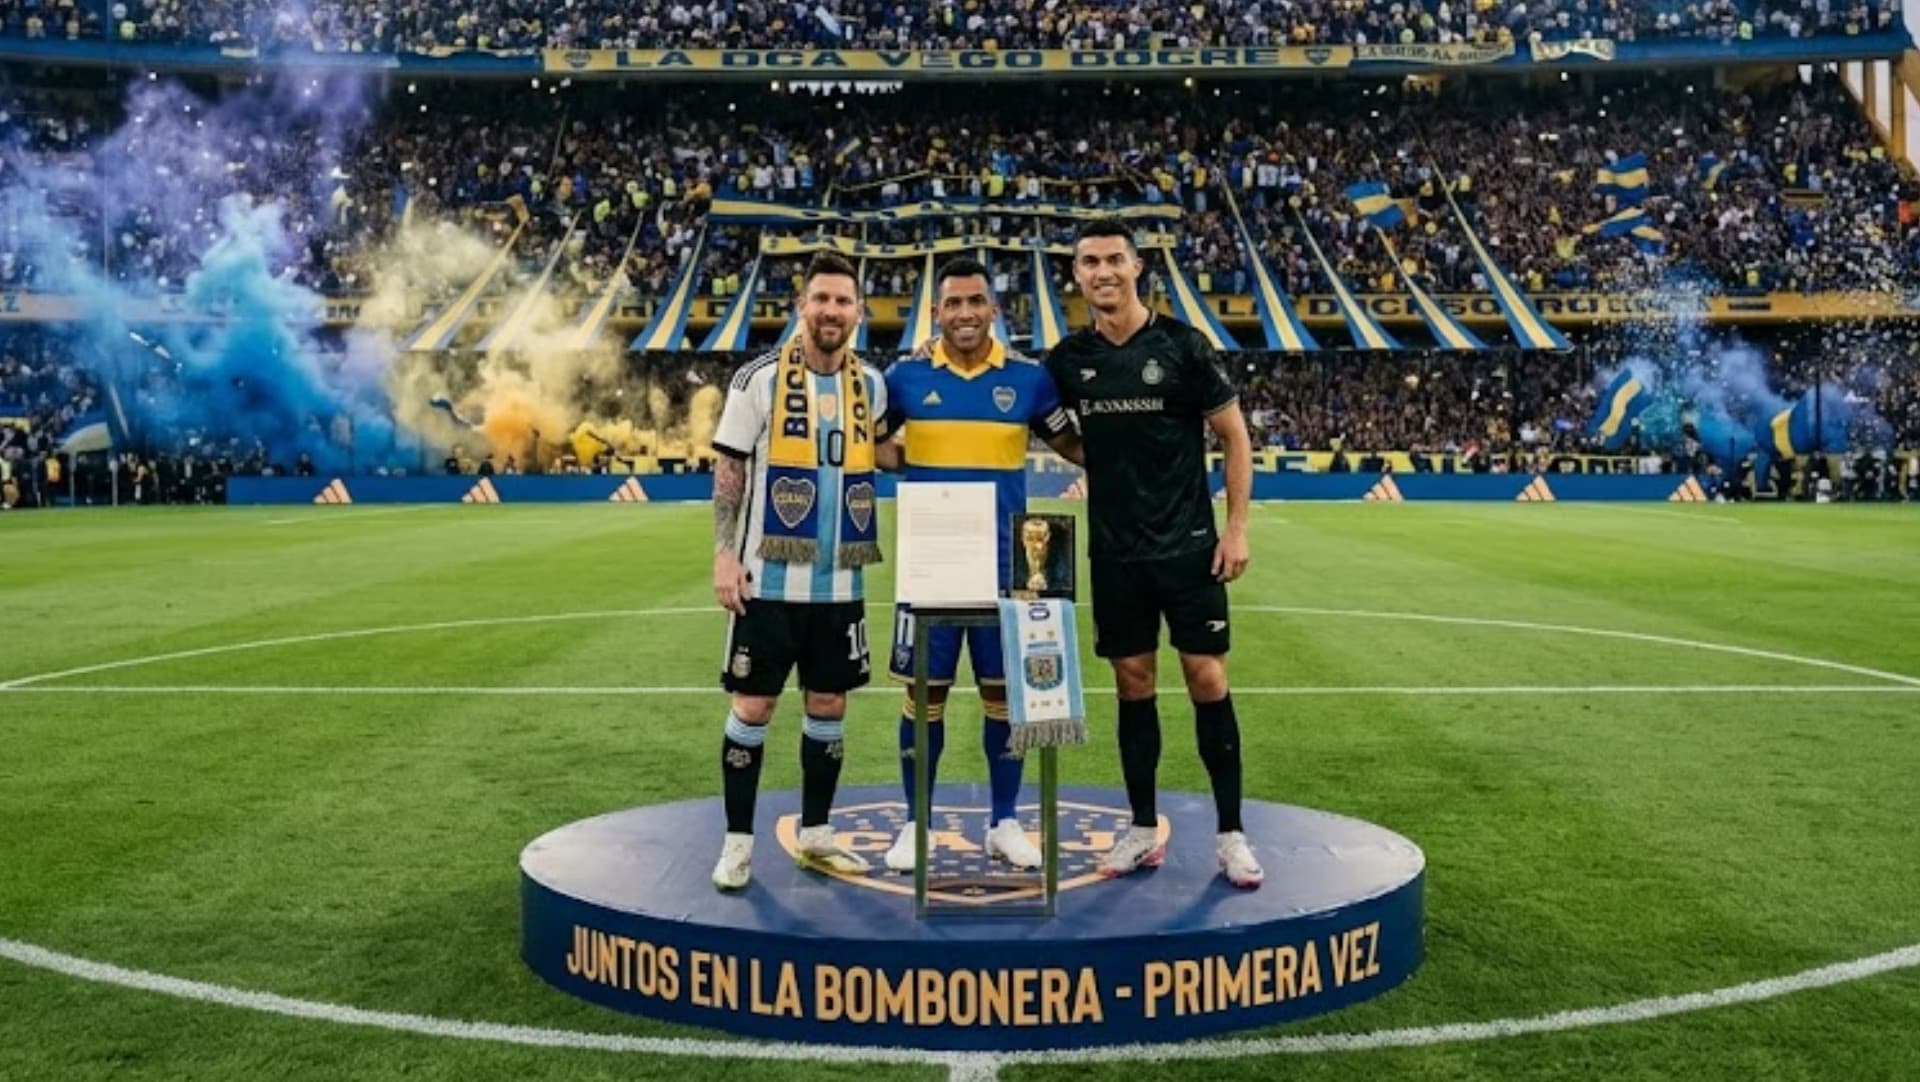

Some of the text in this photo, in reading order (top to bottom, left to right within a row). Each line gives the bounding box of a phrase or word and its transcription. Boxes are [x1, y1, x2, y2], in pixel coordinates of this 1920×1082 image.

[616, 50, 693, 67] LA
[567, 925, 680, 1001] JUNTOS
[690, 949, 739, 1010] EN
[749, 958, 803, 1019] LA
[815, 964, 1104, 1027] BOMBONERA
[1144, 940, 1322, 1019] PRIMERA
[1329, 921, 1381, 988] VEZ
